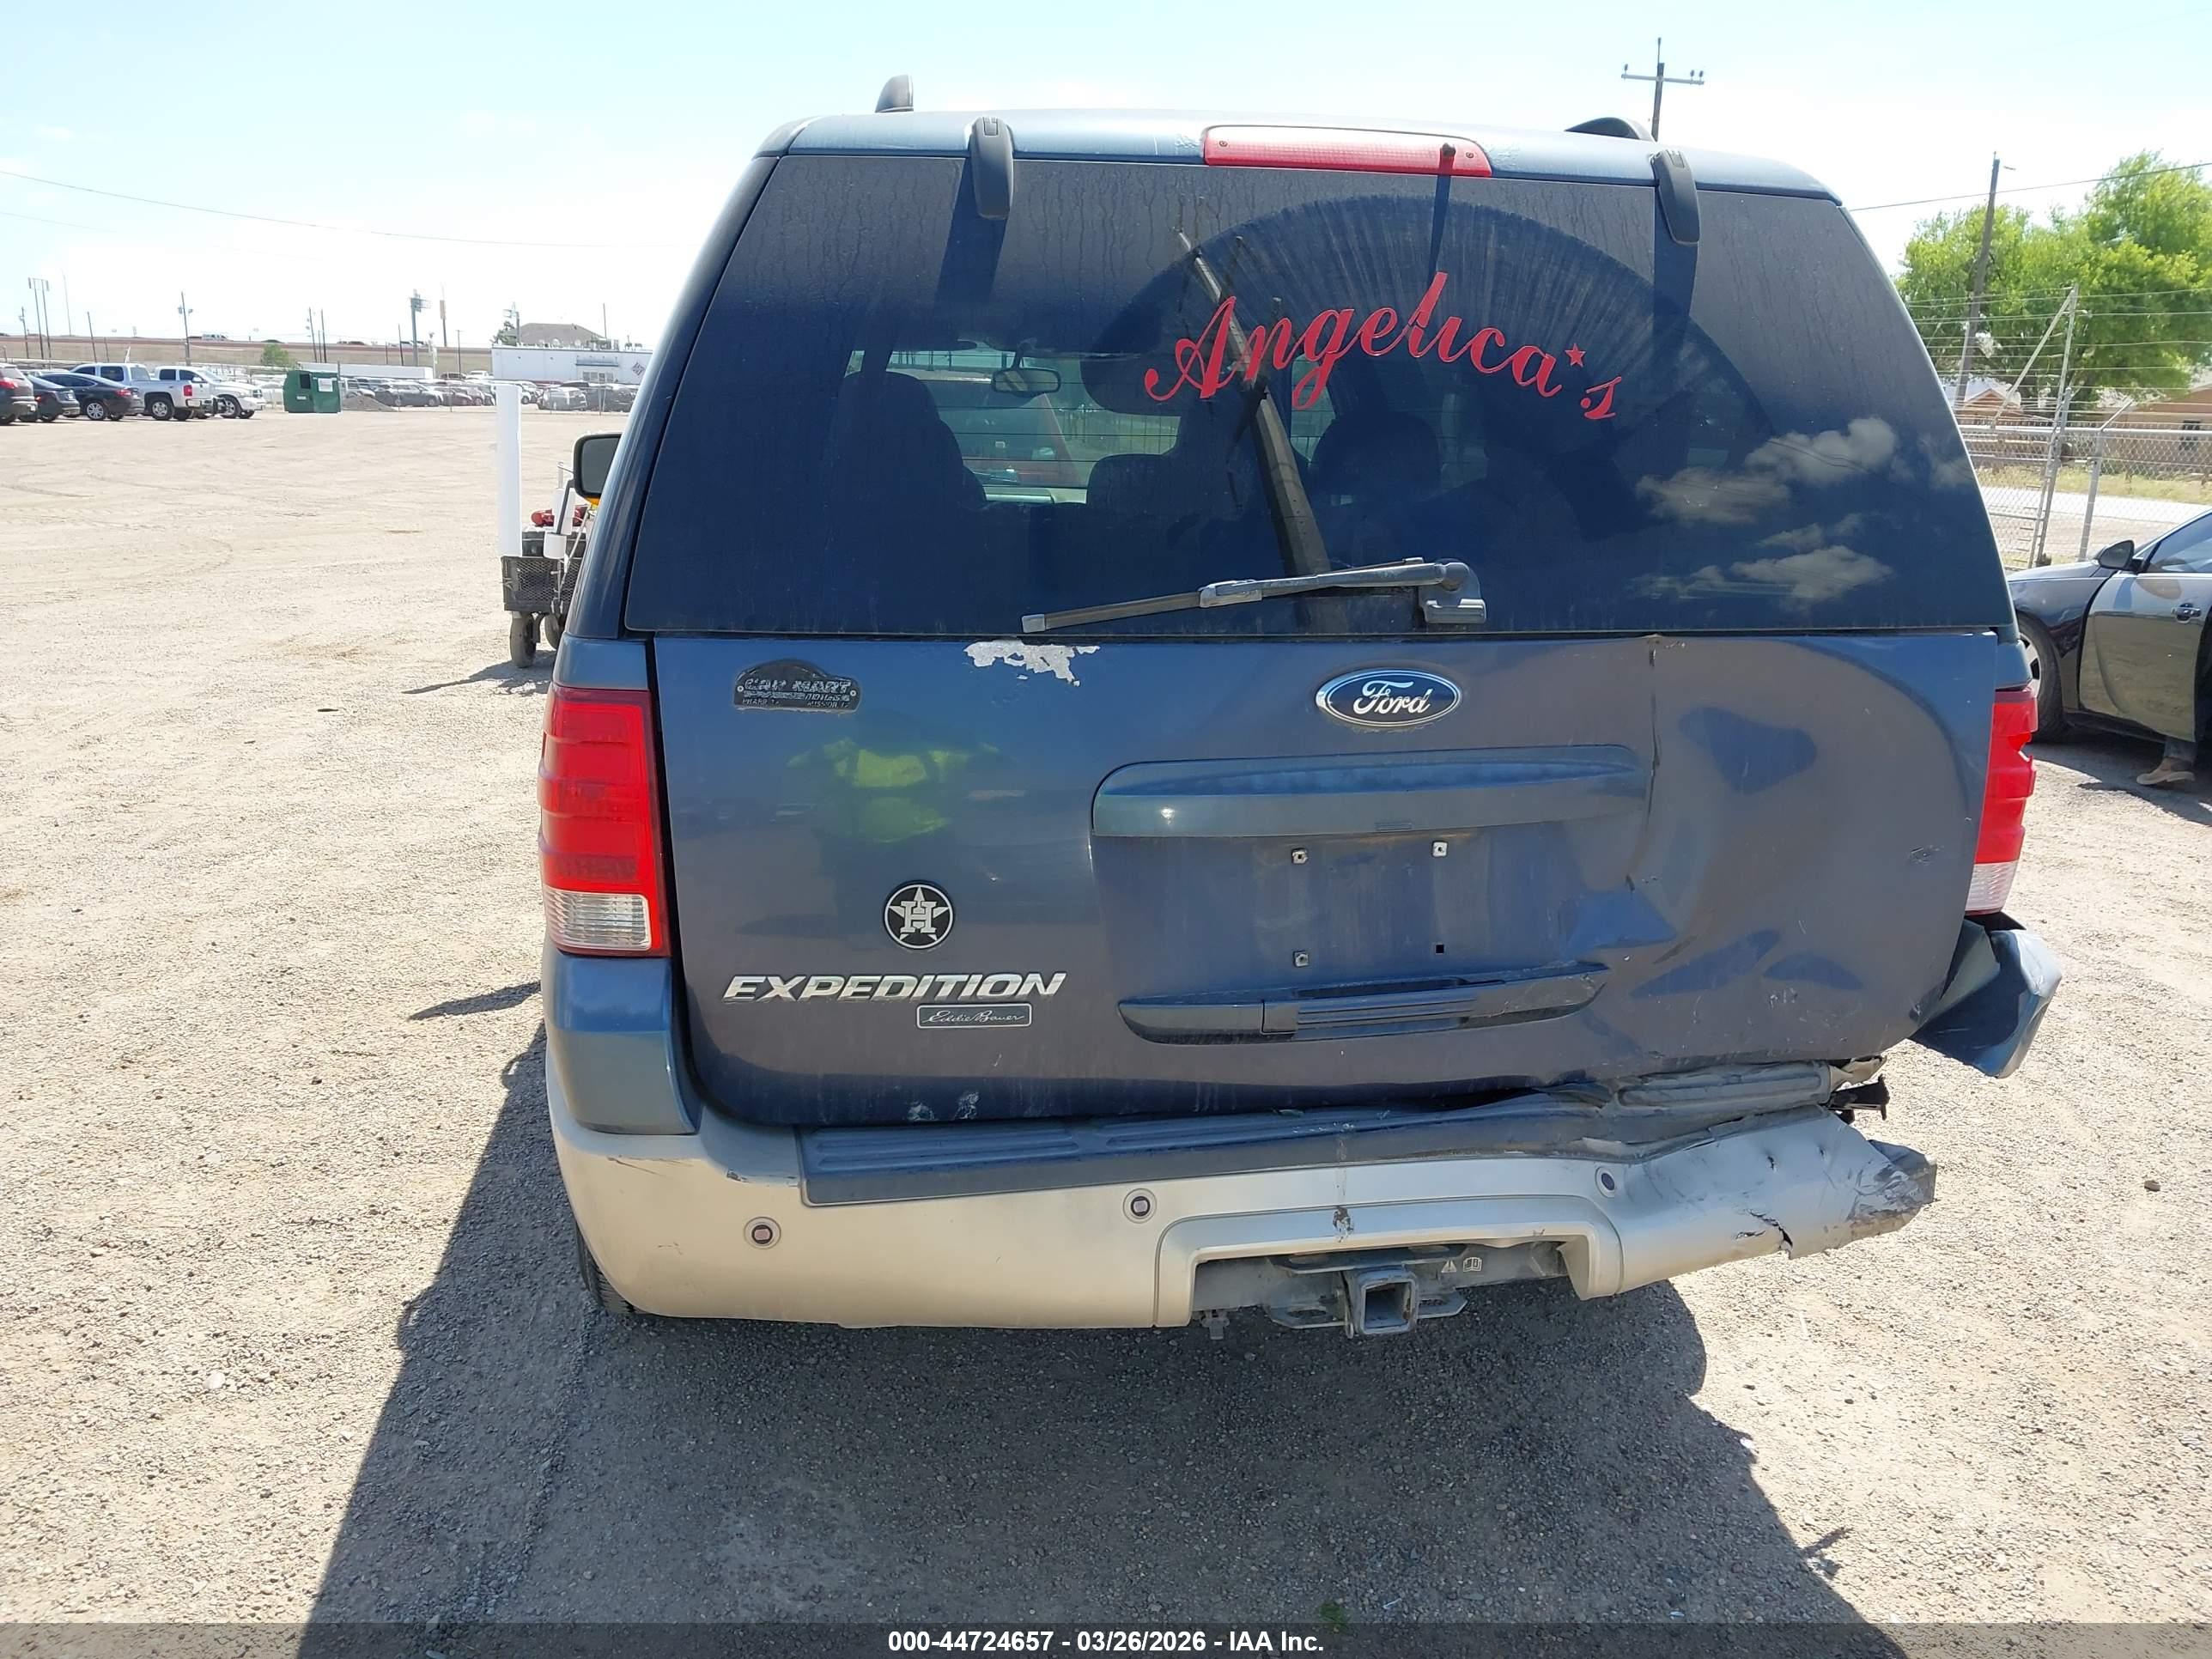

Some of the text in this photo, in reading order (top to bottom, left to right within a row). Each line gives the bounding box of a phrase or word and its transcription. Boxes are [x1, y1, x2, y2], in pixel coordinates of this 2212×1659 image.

[1352, 680, 1433, 714] Ford
[722, 972, 1067, 1002] EXPEDITION
[922, 1010, 1025, 1023] Eddie Bauer
